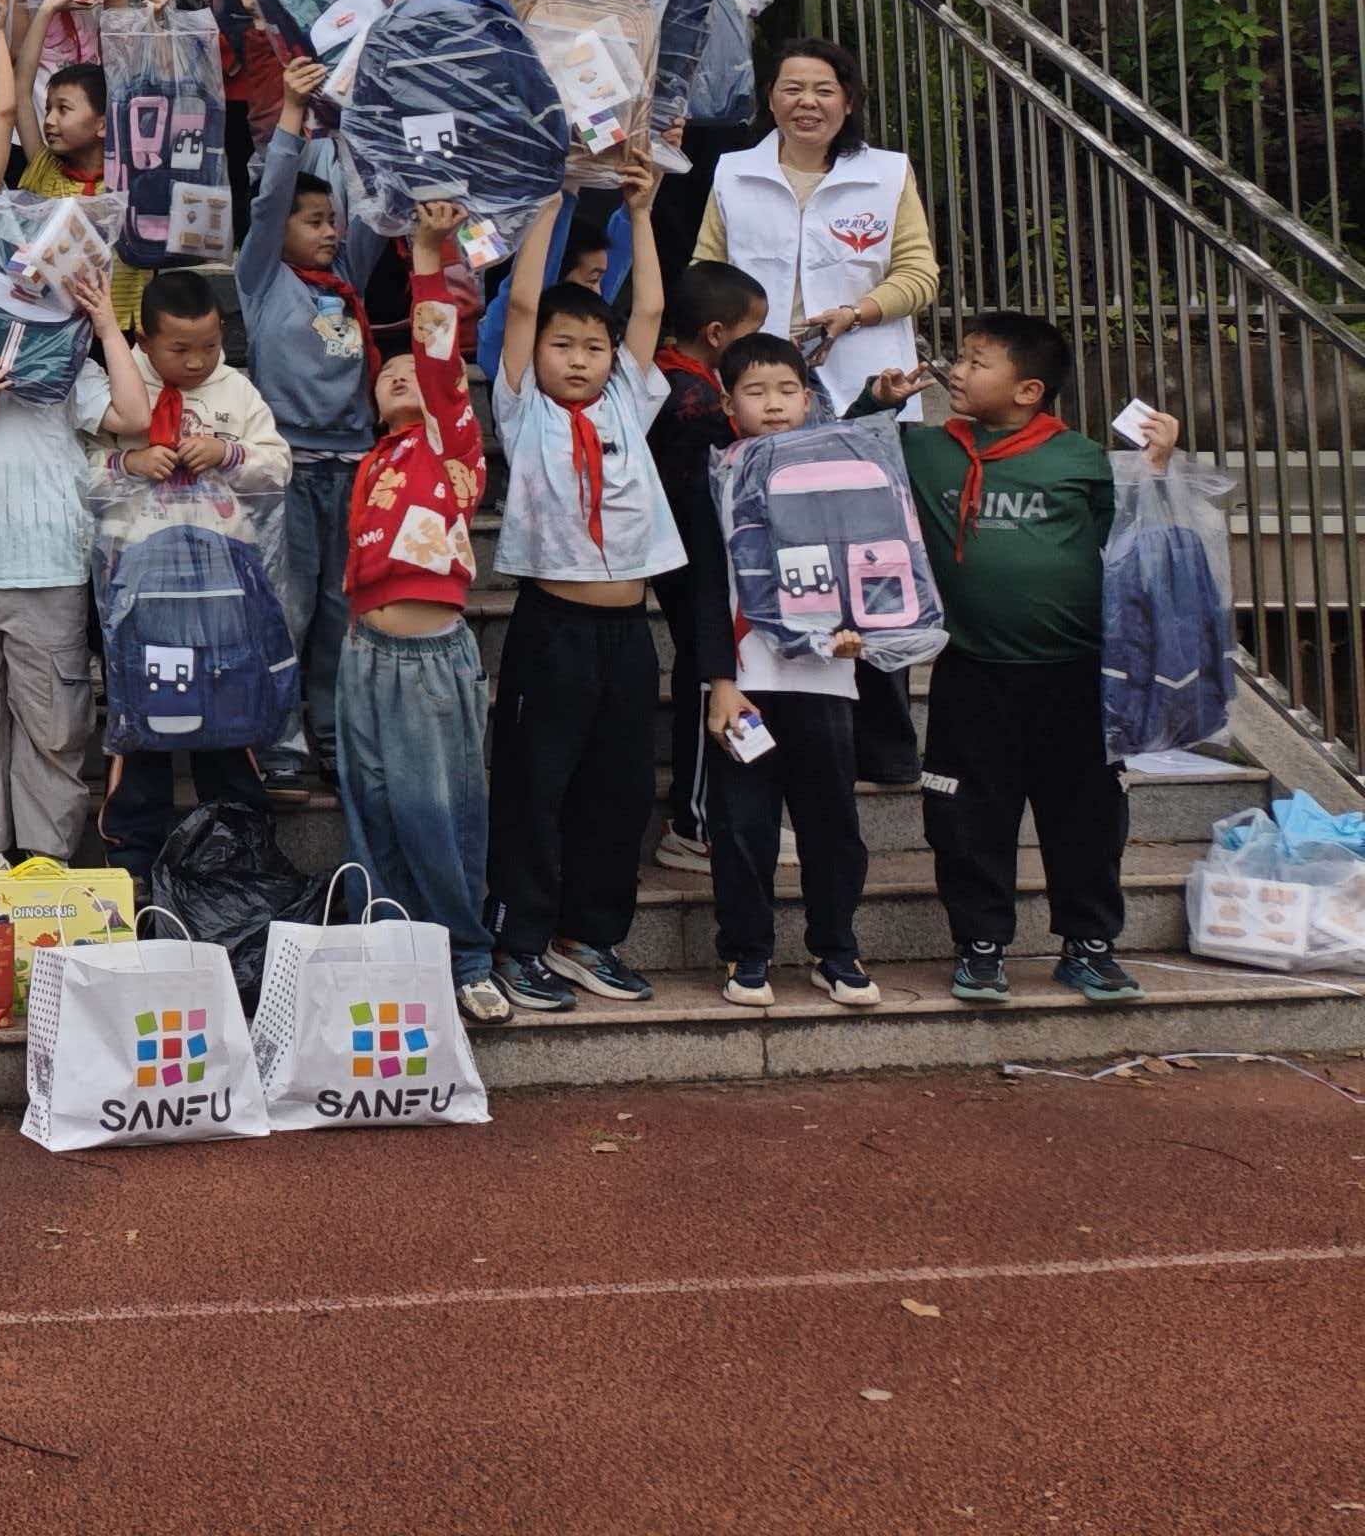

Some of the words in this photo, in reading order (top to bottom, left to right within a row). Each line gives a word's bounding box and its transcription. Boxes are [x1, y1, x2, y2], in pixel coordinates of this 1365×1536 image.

[940, 489, 1048, 518] CINA
[12, 903, 78, 920] DINOSAUR
[99, 1086, 231, 1132] SANFU
[315, 1082, 455, 1119] SANFU
